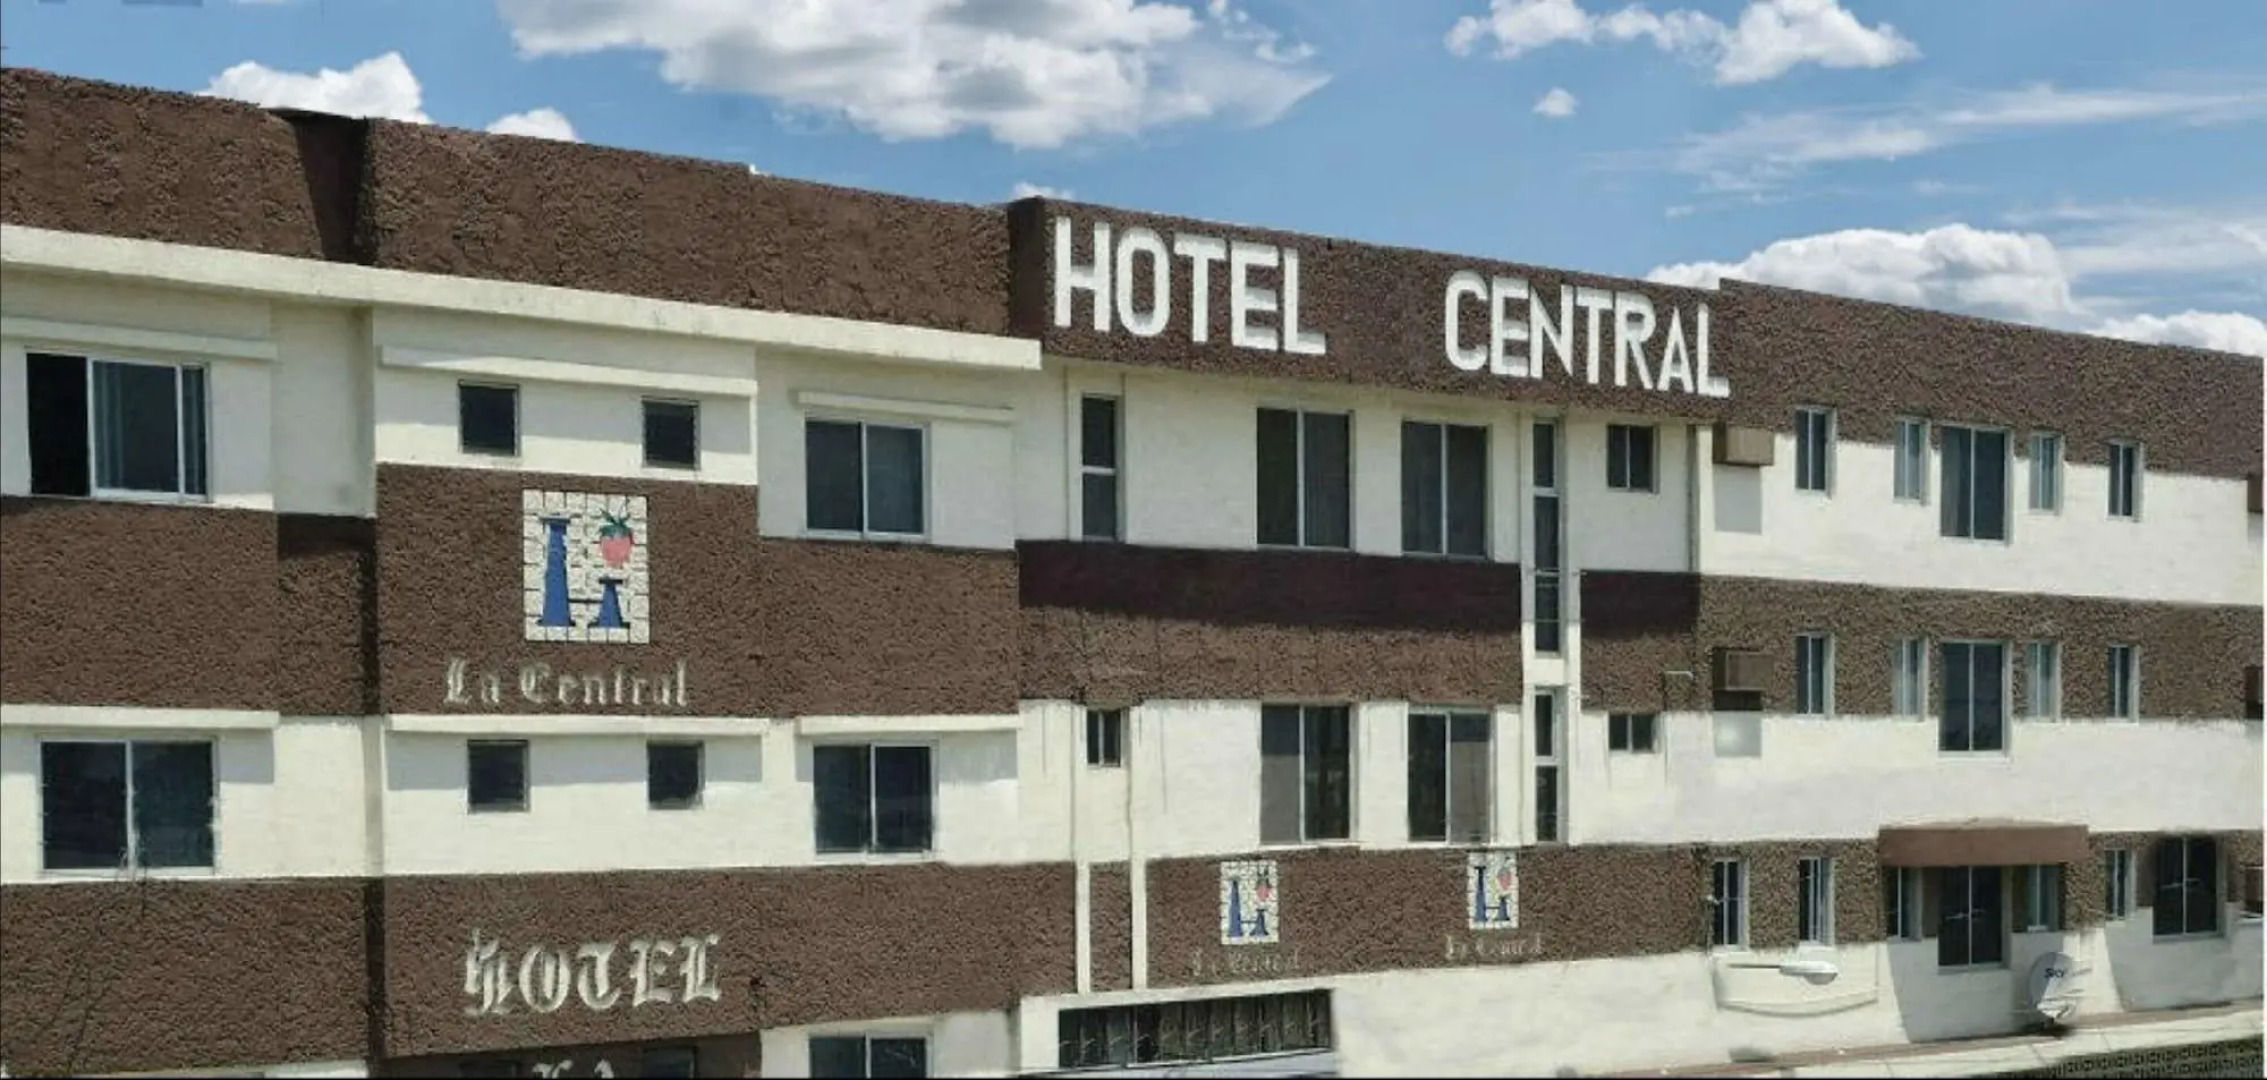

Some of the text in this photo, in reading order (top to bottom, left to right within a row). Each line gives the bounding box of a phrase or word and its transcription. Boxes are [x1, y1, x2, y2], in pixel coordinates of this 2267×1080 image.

[1054, 215, 1731, 399] HOTEL CENTRAL
[444, 656, 688, 707] La Central
[464, 927, 722, 1016] HOTEL
